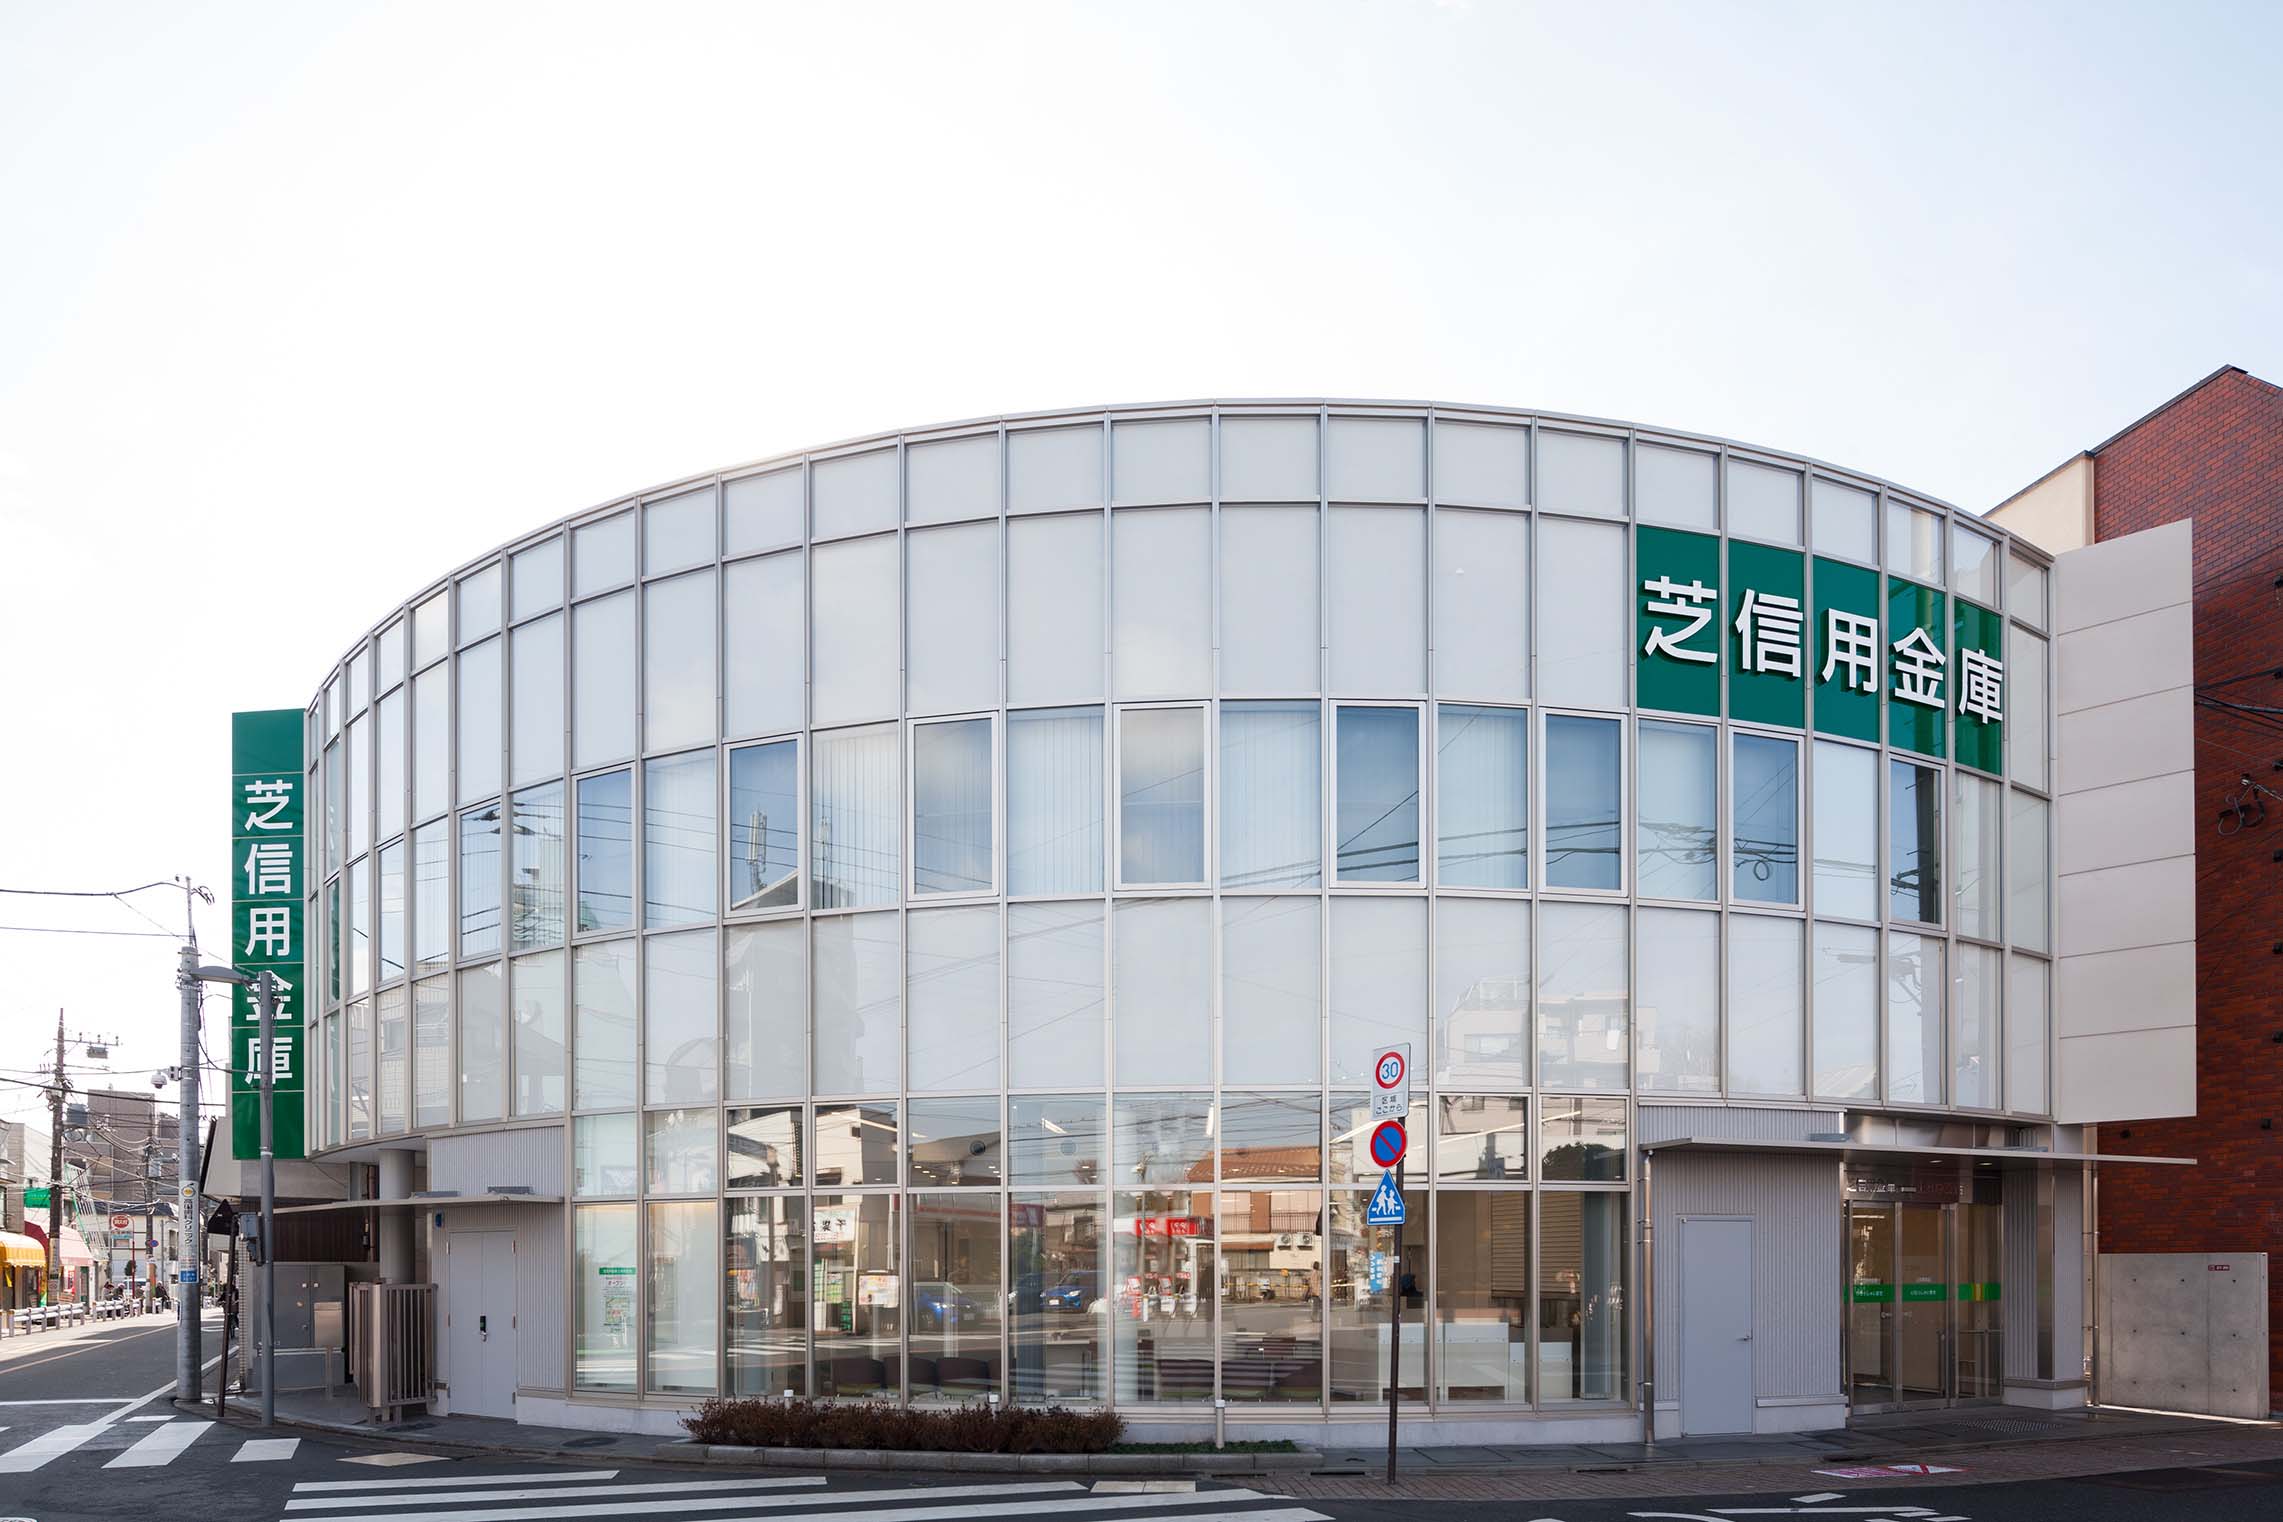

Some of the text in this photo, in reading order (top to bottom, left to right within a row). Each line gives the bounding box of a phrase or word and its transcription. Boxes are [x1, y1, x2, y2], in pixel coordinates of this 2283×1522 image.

[1644, 575, 2003, 725] 芝信用金庫
[244, 779, 294, 1085] 芝信用金庫
[1375, 1103, 1402, 1114] ここから
[1381, 1061, 1399, 1080] 30
